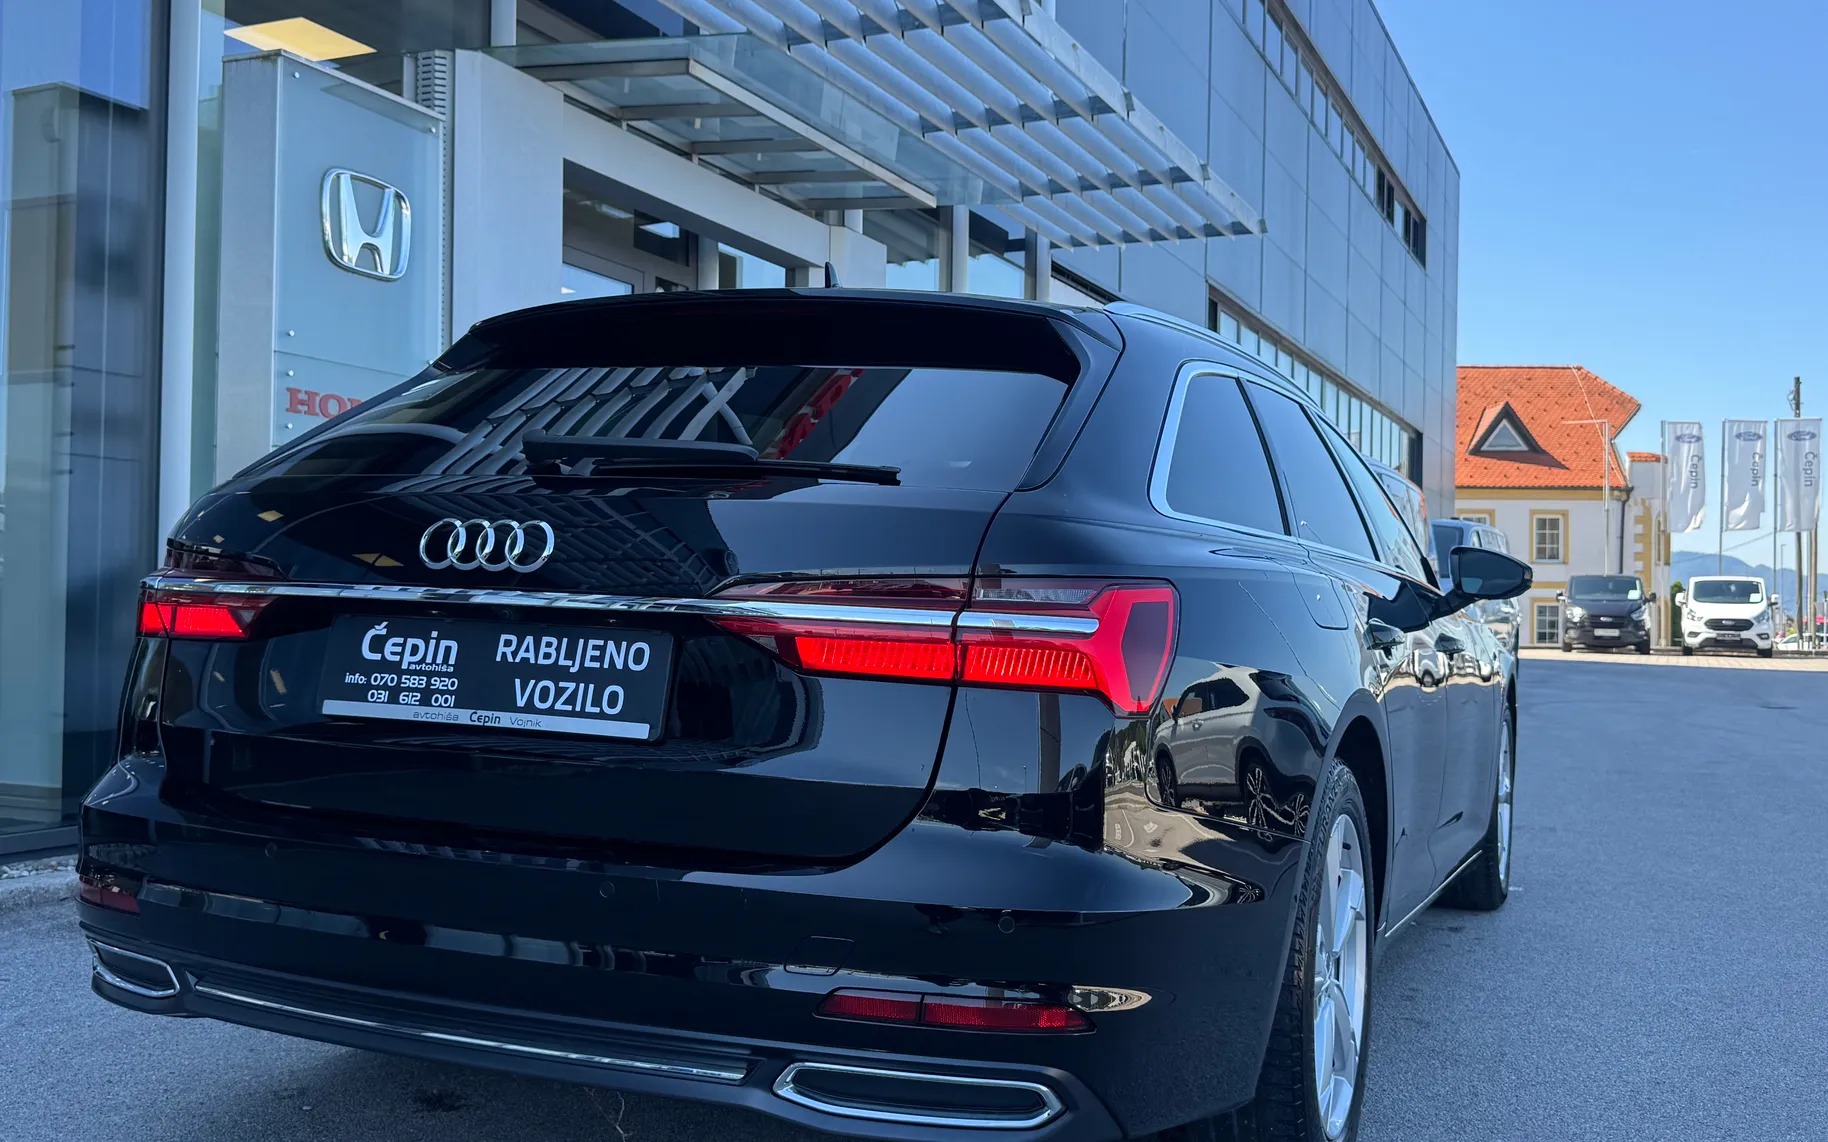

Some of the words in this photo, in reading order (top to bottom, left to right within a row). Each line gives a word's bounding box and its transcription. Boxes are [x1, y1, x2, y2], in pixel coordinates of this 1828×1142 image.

[1689, 454, 1702, 489] Čepin
[1803, 451, 1817, 487] Čepin
[361, 621, 458, 669] Čepin
[496, 634, 650, 672] RABLJENO
[344, 672, 367, 684] info:
[370, 673, 397, 687] 070
[400, 675, 427, 688] 583
[430, 677, 458, 690] 920
[409, 663, 454, 672] avtohiša
[367, 689, 388, 703] 031
[399, 692, 421, 705] 612
[431, 694, 455, 707] 001
[515, 678, 625, 715] VOZILO
[412, 711, 459, 721] avtohiša
[469, 710, 501, 726] Čepin
[509, 716, 542, 728] Vojnik
